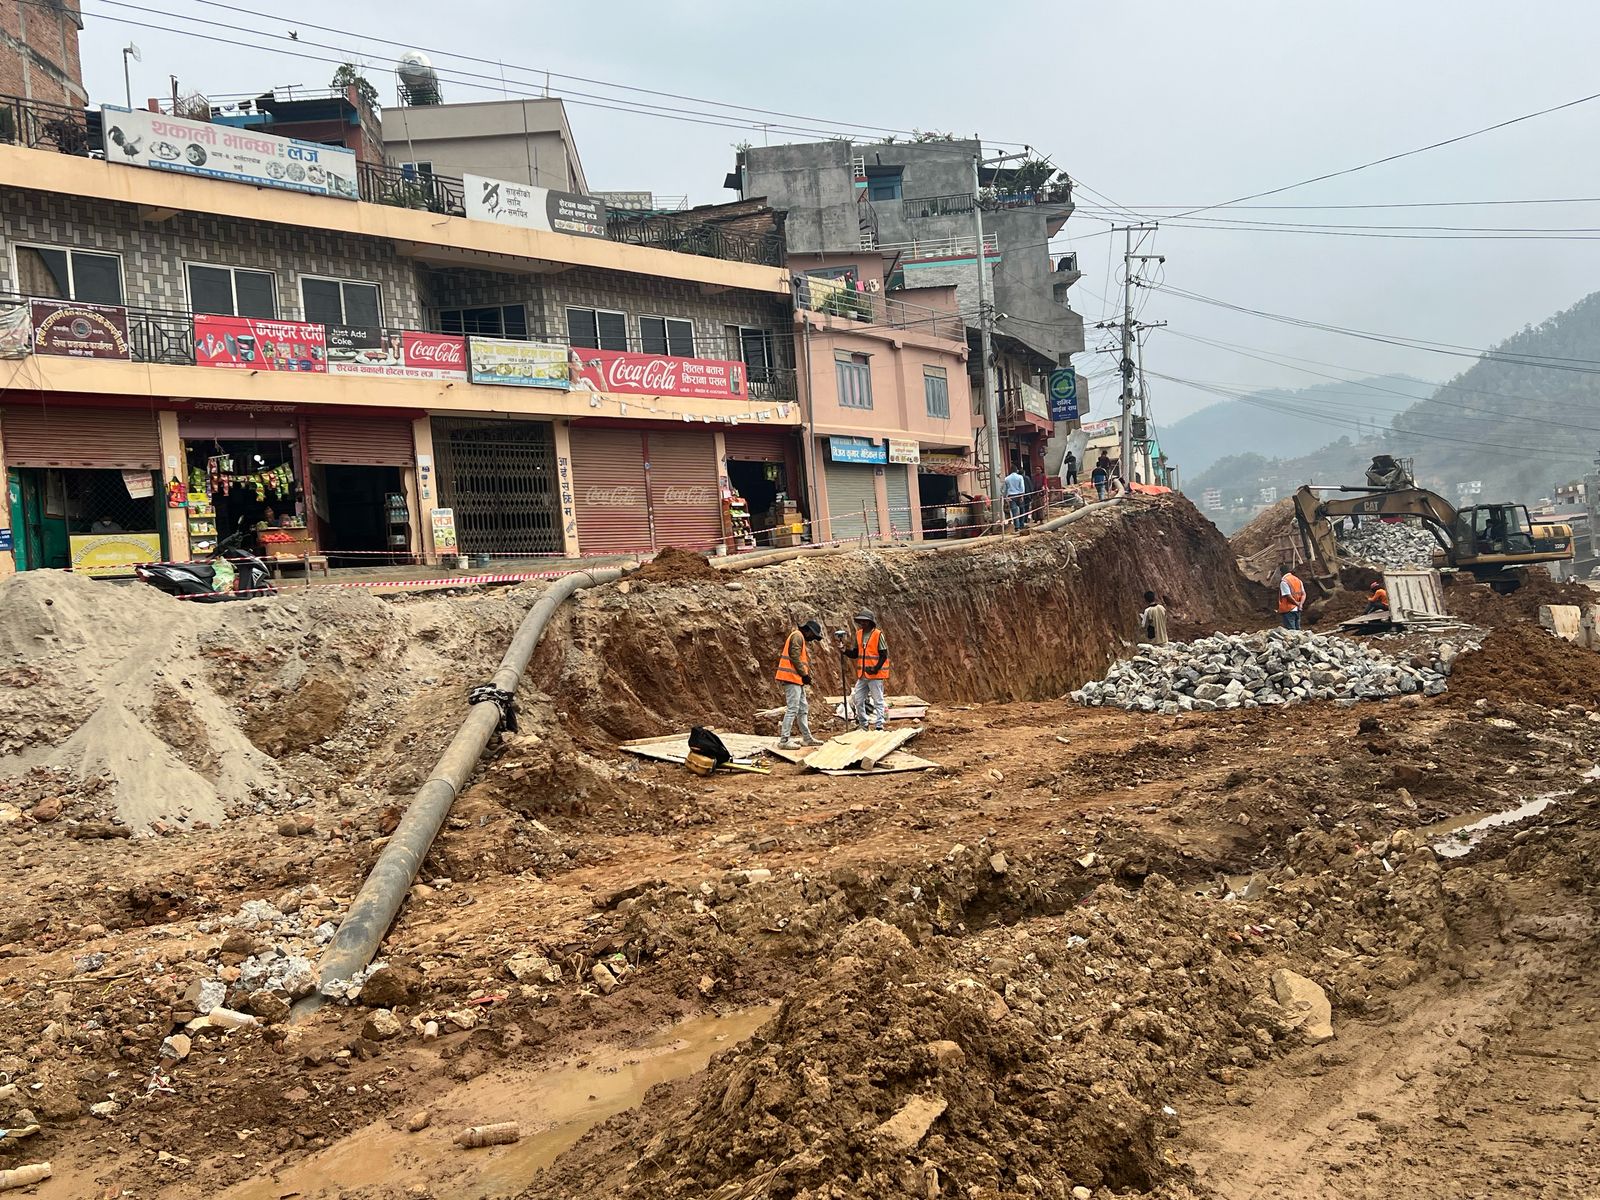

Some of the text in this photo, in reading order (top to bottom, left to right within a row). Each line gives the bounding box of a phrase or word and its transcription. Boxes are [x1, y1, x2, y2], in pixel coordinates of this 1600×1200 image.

[151, 119, 217, 146] थकाली
[223, 129, 276, 156] भान्छा
[287, 146, 319, 162] लज
[256, 322, 297, 342] करापुटार
[331, 328, 367, 339] Just Add
[409, 340, 462, 363] Coca-Cola
[385, 366, 404, 376] होटल
[420, 370, 434, 378] लज
[608, 357, 678, 390] Coca-Cola
[682, 373, 727, 386] किराना पसल
[1363, 501, 1379, 511] CAT
